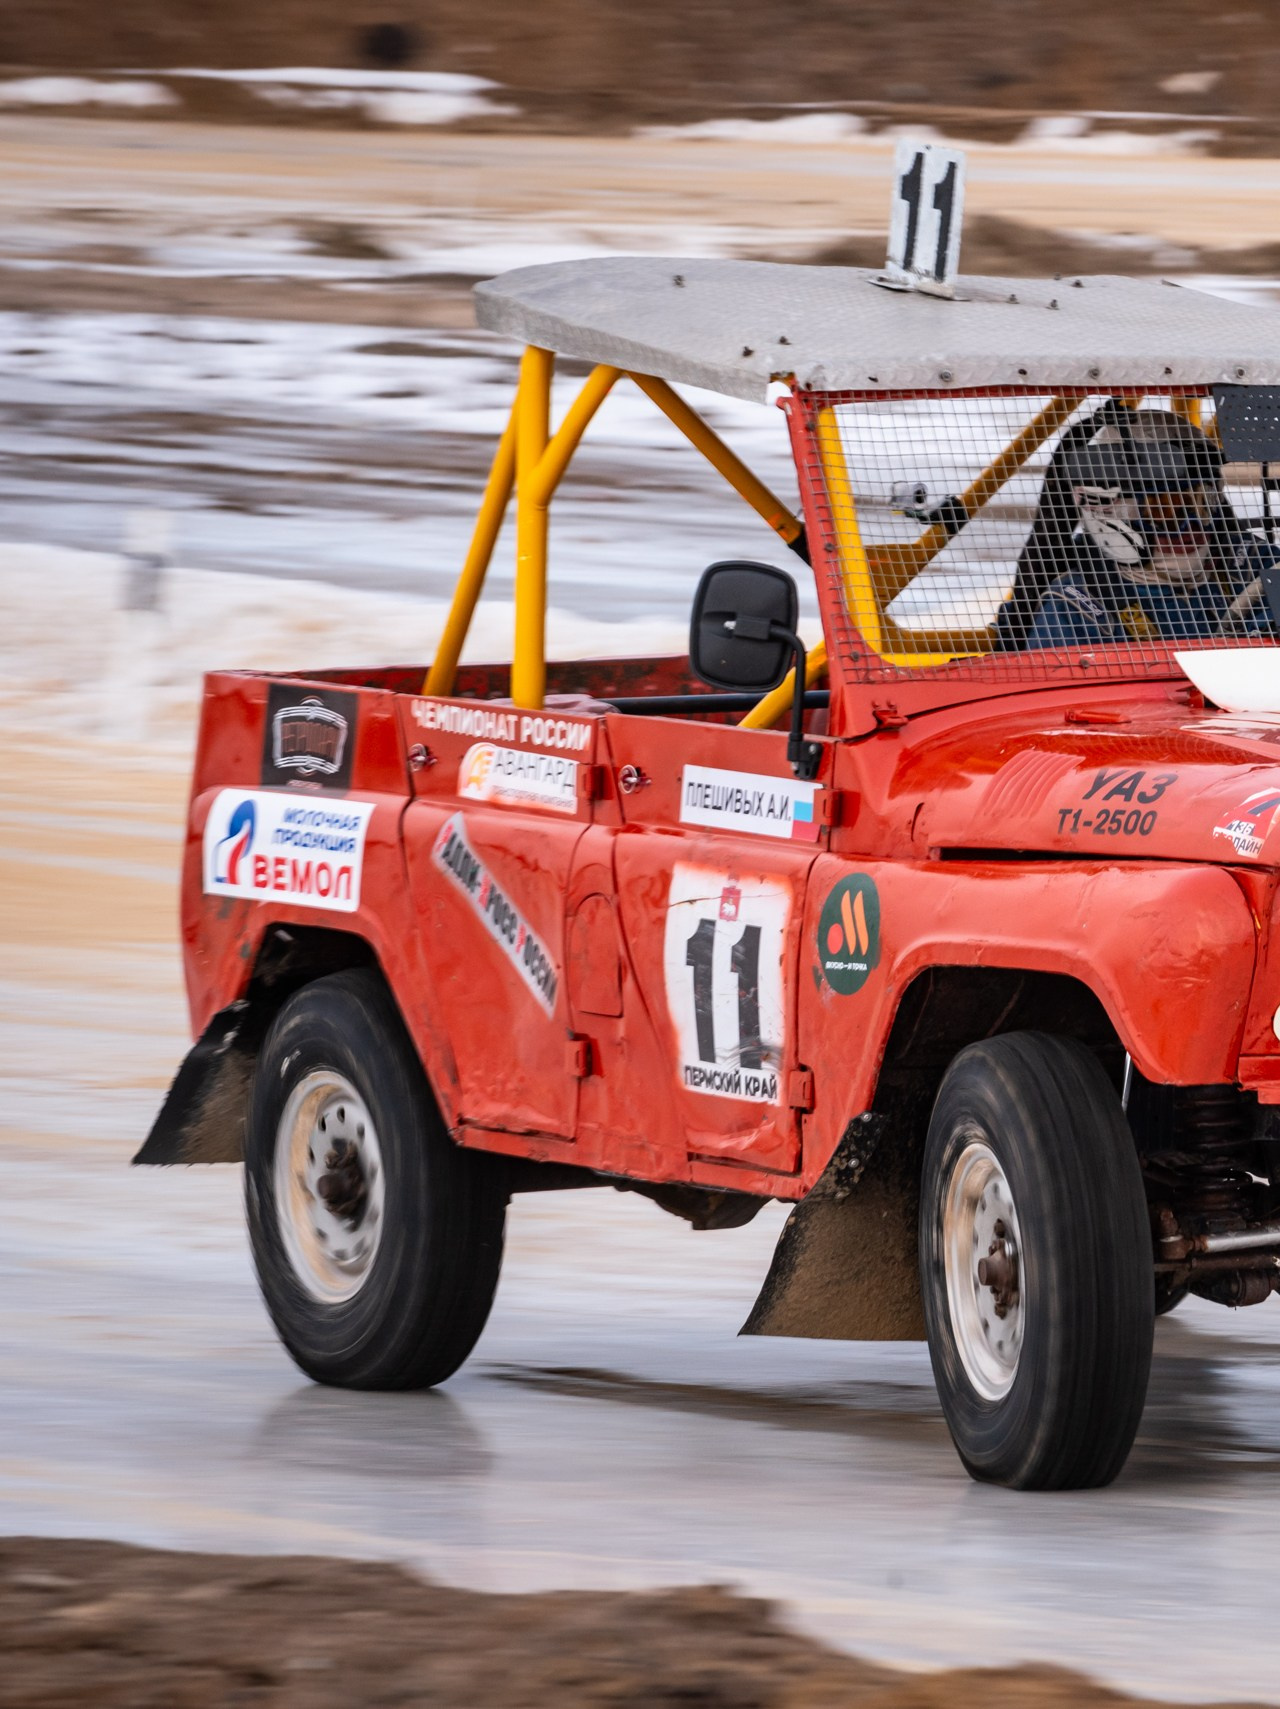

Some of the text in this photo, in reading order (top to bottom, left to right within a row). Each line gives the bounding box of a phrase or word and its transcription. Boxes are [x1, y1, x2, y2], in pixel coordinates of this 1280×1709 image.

[900, 152, 957, 283] 11
[411, 699, 592, 751] ЧЕМПИОНАТ РОССИИ
[493, 750, 576, 793] АВАНГАРД
[1082, 768, 1179, 804] УАЗ
[282, 808, 361, 831] МОЛОЧНАЯ
[686, 781, 792, 822] ПЛЕШИВЫХ А.И.
[1057, 808, 1158, 836] Т1-2500
[271, 827, 356, 853] ПРОДУКЦИЯ
[253, 854, 353, 900] ВЕМОЛ
[685, 918, 763, 1071] 11
[684, 1065, 778, 1100] ПЕРМСКИЙ КРАЙ
